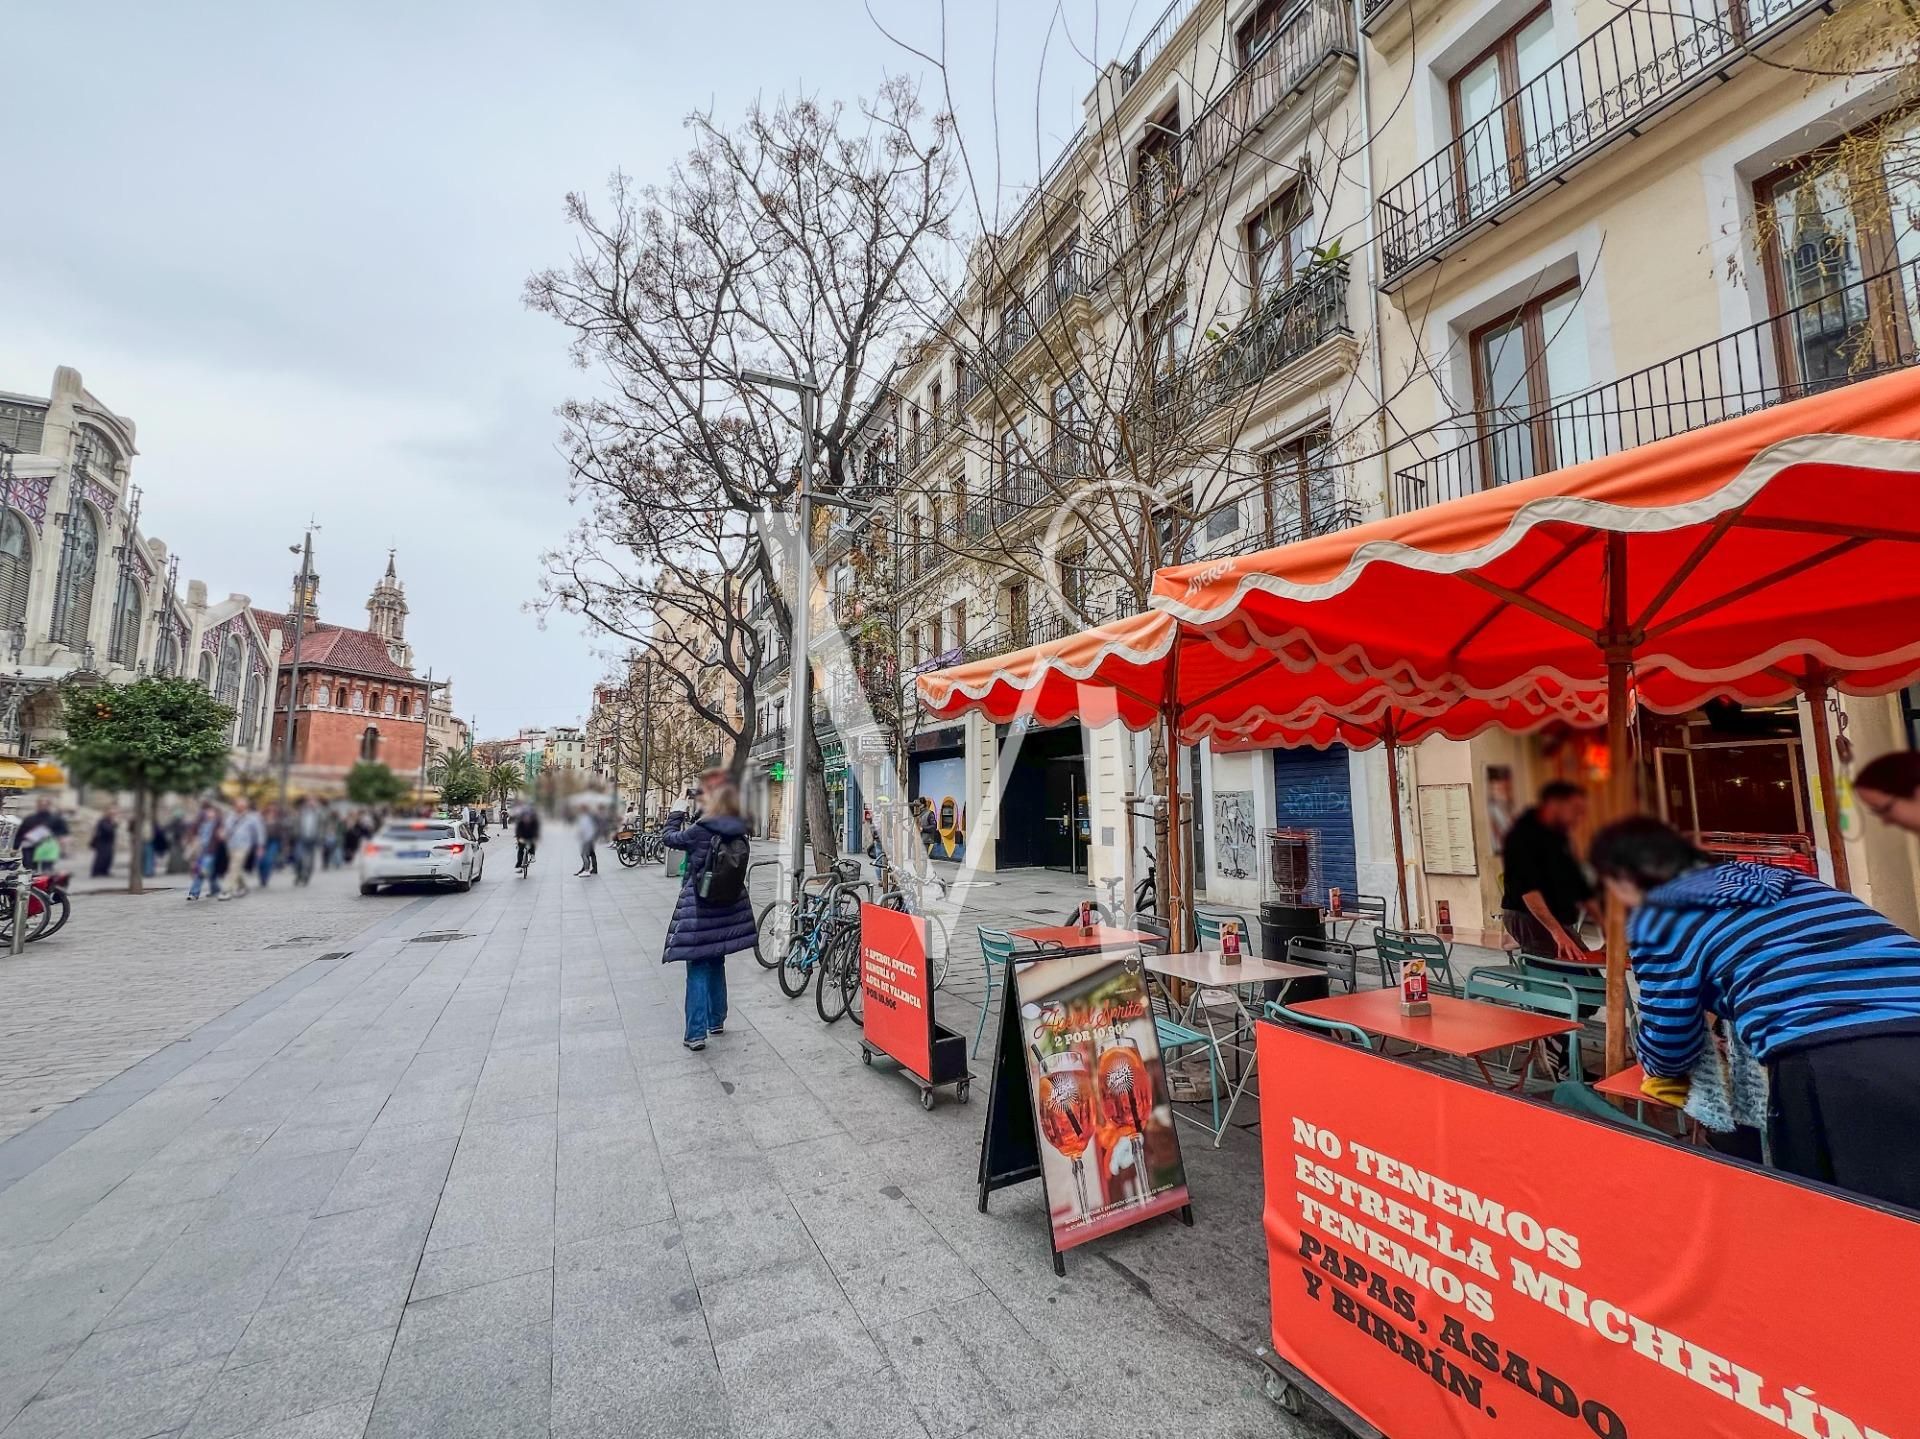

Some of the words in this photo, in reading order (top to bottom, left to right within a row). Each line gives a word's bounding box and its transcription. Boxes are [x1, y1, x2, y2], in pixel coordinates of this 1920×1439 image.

[1184, 561, 1236, 598] APEROL
[869, 948, 892, 967] APEROL
[866, 973, 880, 989] AGUA
[880, 980, 890, 993] DE
[890, 984, 922, 1009] VALENCIA
[890, 971, 896, 982] O
[1094, 999, 1145, 1028] Spritz
[1055, 1036, 1062, 1047] 2
[1064, 1031, 1092, 1046] POR
[1292, 1116, 1342, 1160] NO
[1350, 1140, 1582, 1270] TENEMOS
[1294, 1153, 1500, 1281] ESTRELLA
[1296, 1191, 1495, 1322] TENEMOS
[1299, 1230, 1428, 1334] PAPAS,
[1439, 1314, 1628, 1439] ASADO
[1302, 1267, 1323, 1301] Y
[1331, 1285, 1498, 1420] BIRRÍN.
